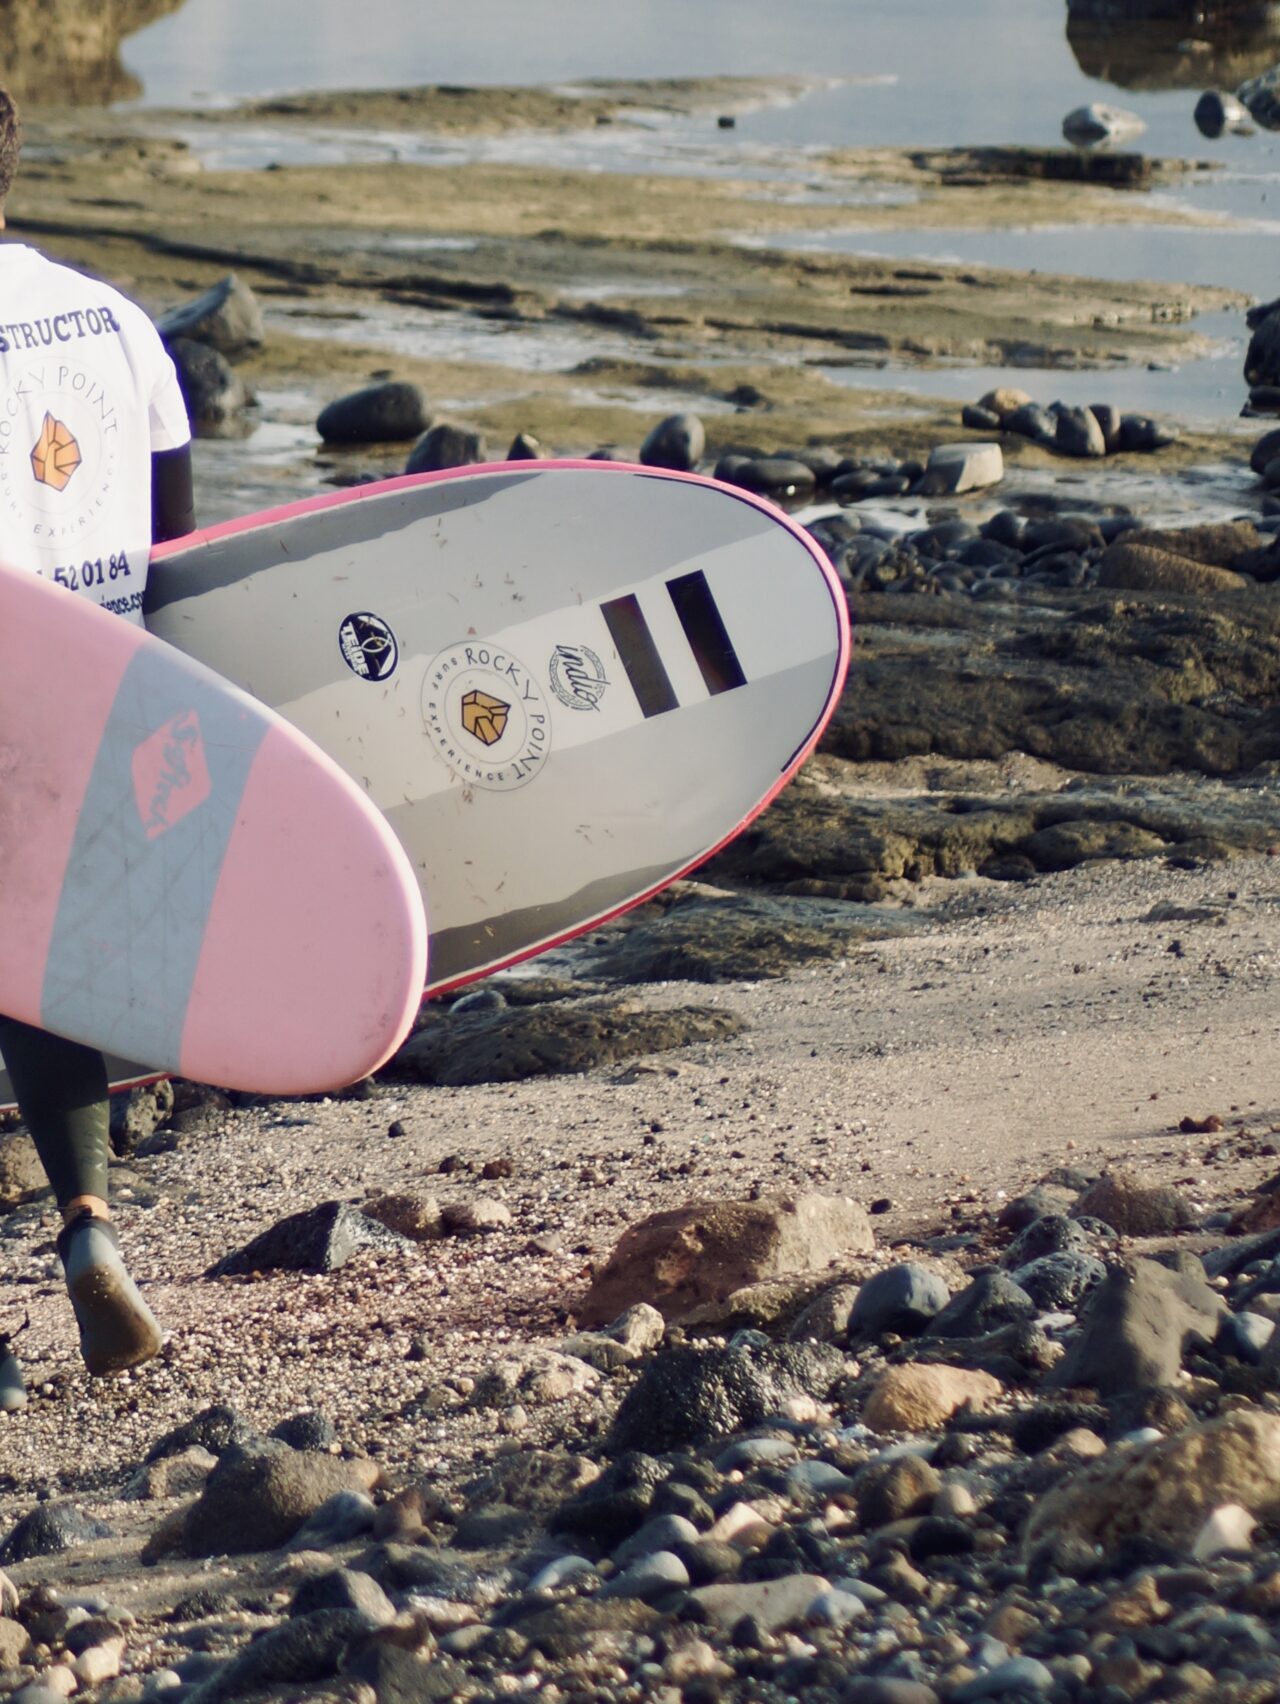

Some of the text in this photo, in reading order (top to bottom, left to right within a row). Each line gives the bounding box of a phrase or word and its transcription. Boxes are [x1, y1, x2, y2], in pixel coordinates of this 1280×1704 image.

[58, 365, 118, 434] POINT
[341, 620, 371, 676] TEIDE
[428, 656, 505, 782] SURF EXPERIENCE
[464, 647, 546, 780] ROCKY POINT
